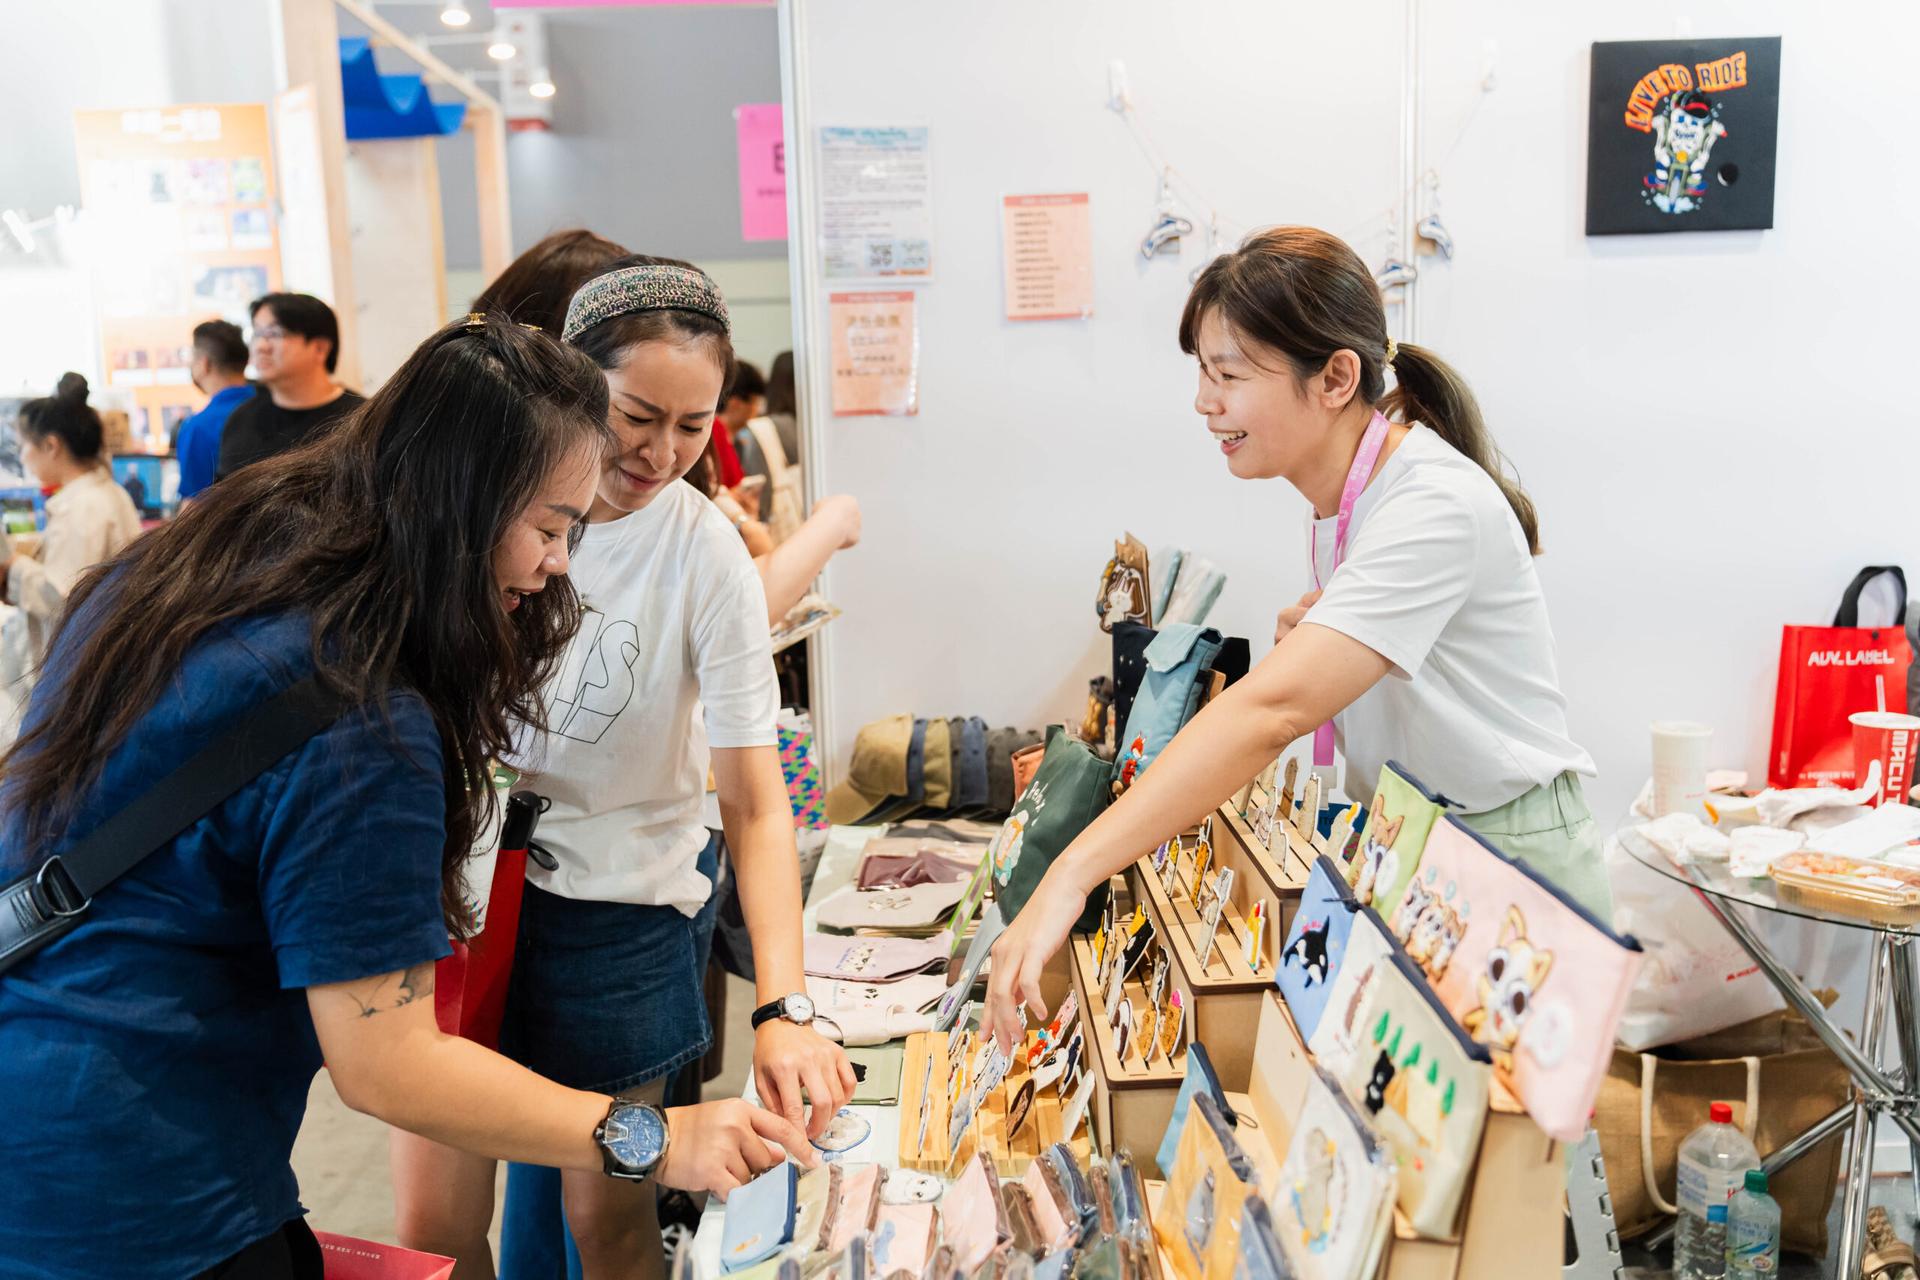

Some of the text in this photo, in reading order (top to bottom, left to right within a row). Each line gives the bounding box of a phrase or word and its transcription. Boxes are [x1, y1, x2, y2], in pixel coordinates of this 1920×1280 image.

[1629, 55, 1744, 130] LIVE TO RIDE
[1845, 649, 1895, 666] LABEL
[1887, 730, 1909, 791] MACU
